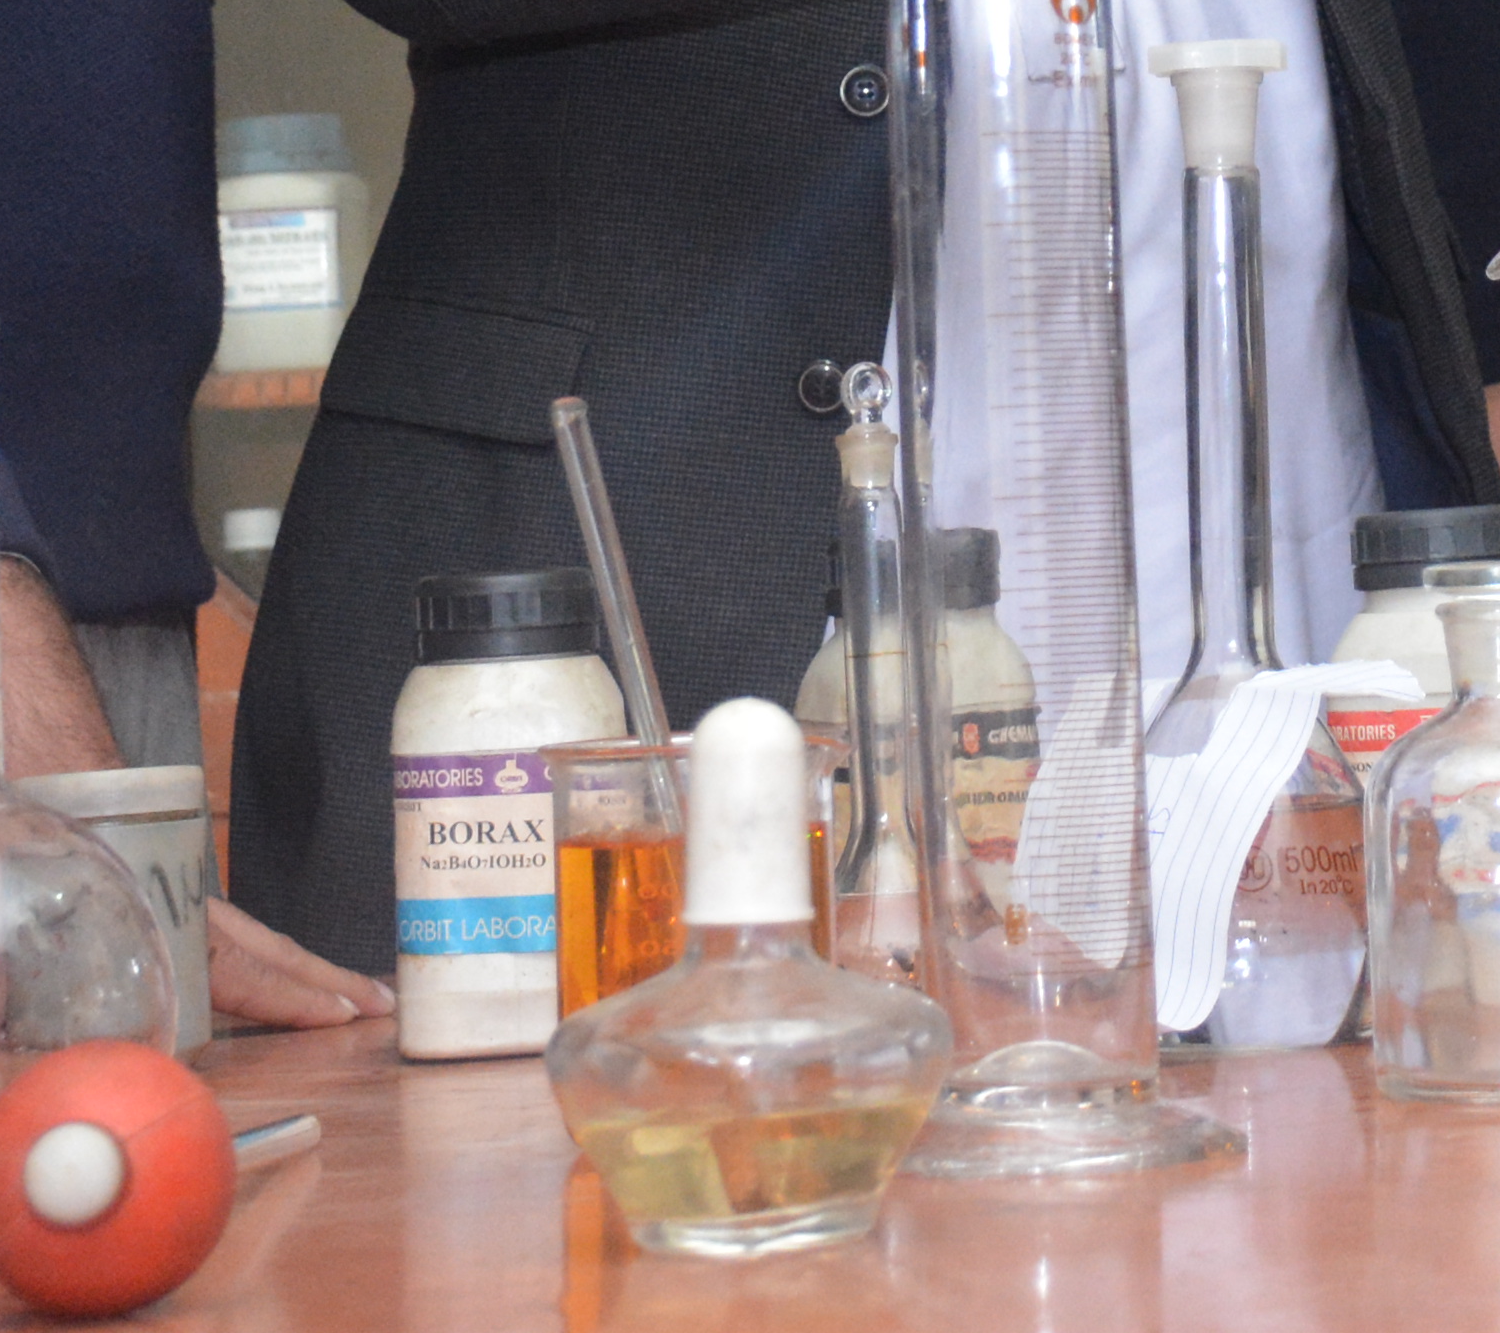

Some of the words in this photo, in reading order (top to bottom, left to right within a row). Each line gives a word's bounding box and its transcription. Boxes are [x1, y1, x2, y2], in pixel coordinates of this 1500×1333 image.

[428, 819, 546, 846] BORAX
[1284, 845, 1358, 874] 500ml
[400, 918, 453, 942] ORBIT
